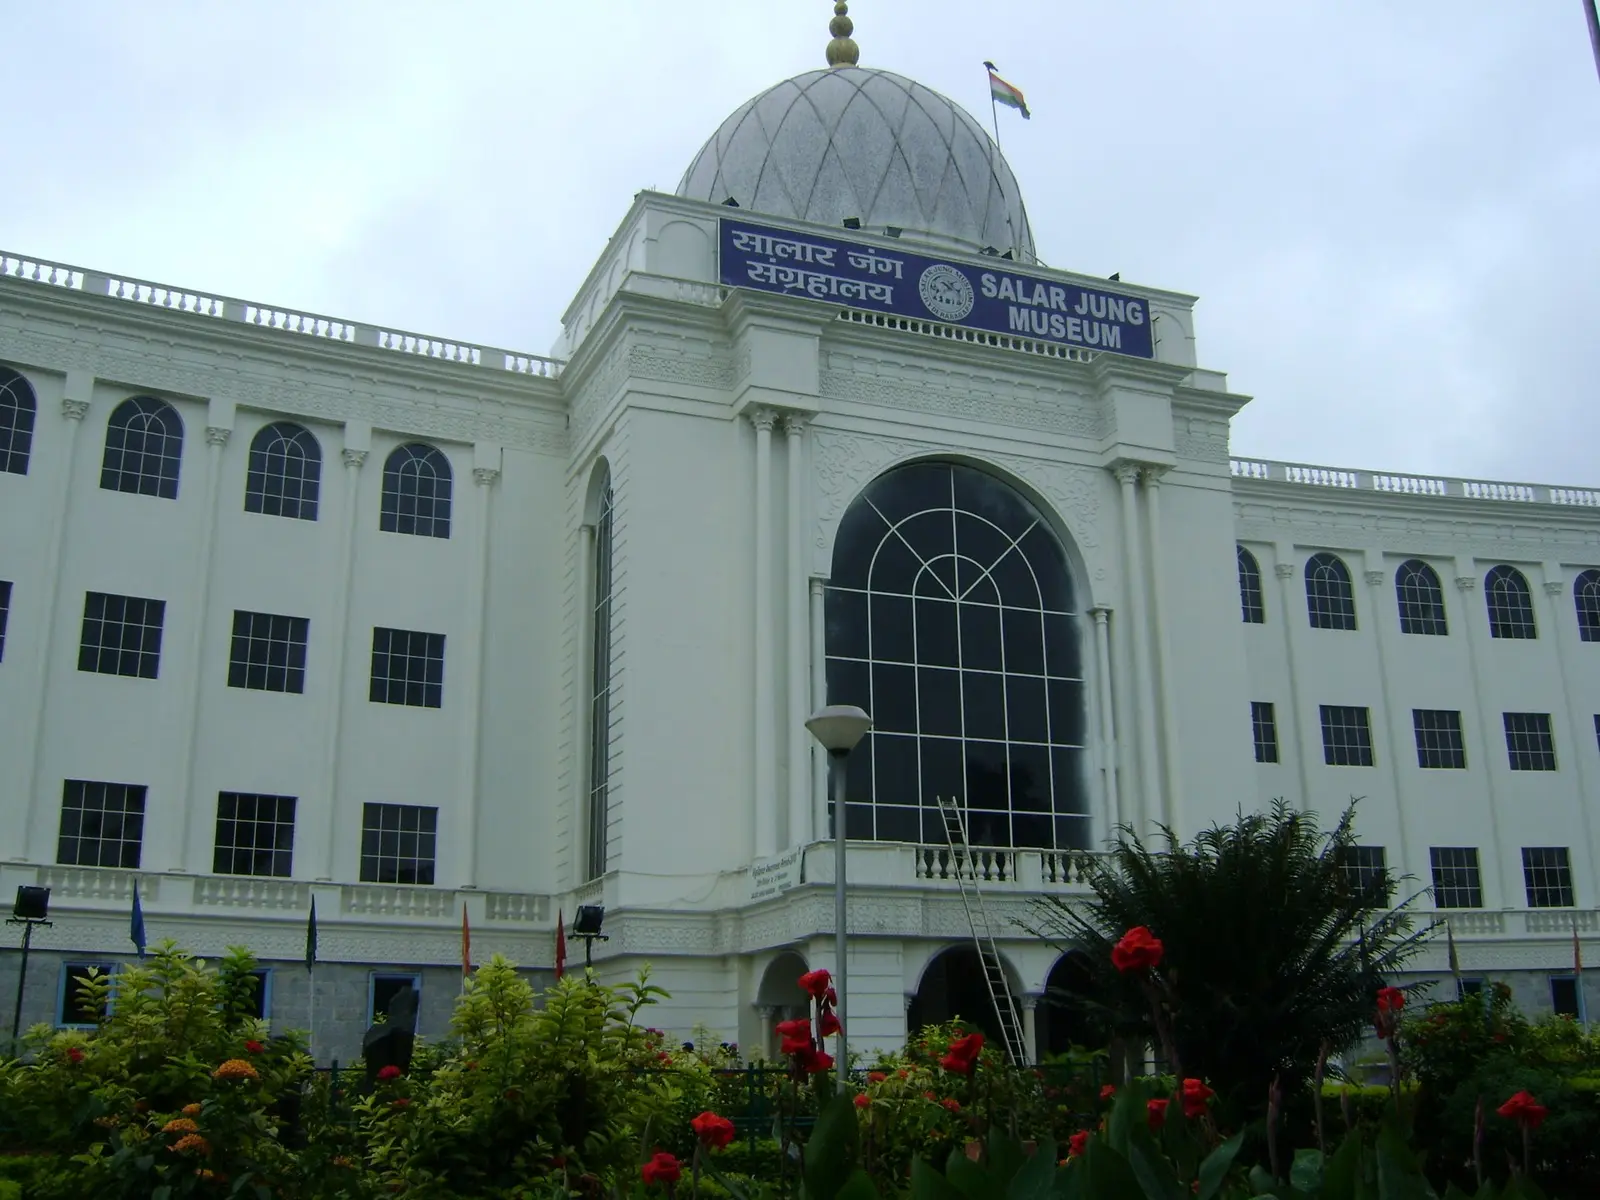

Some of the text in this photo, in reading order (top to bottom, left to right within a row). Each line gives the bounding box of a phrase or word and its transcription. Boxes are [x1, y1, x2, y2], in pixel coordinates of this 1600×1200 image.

[732, 230, 903, 279] सालार जंग
[746, 259, 893, 306] संग्रहालय
[981, 273, 1143, 326] SALAR JUNG
[1009, 306, 1121, 348] MUSEUM
